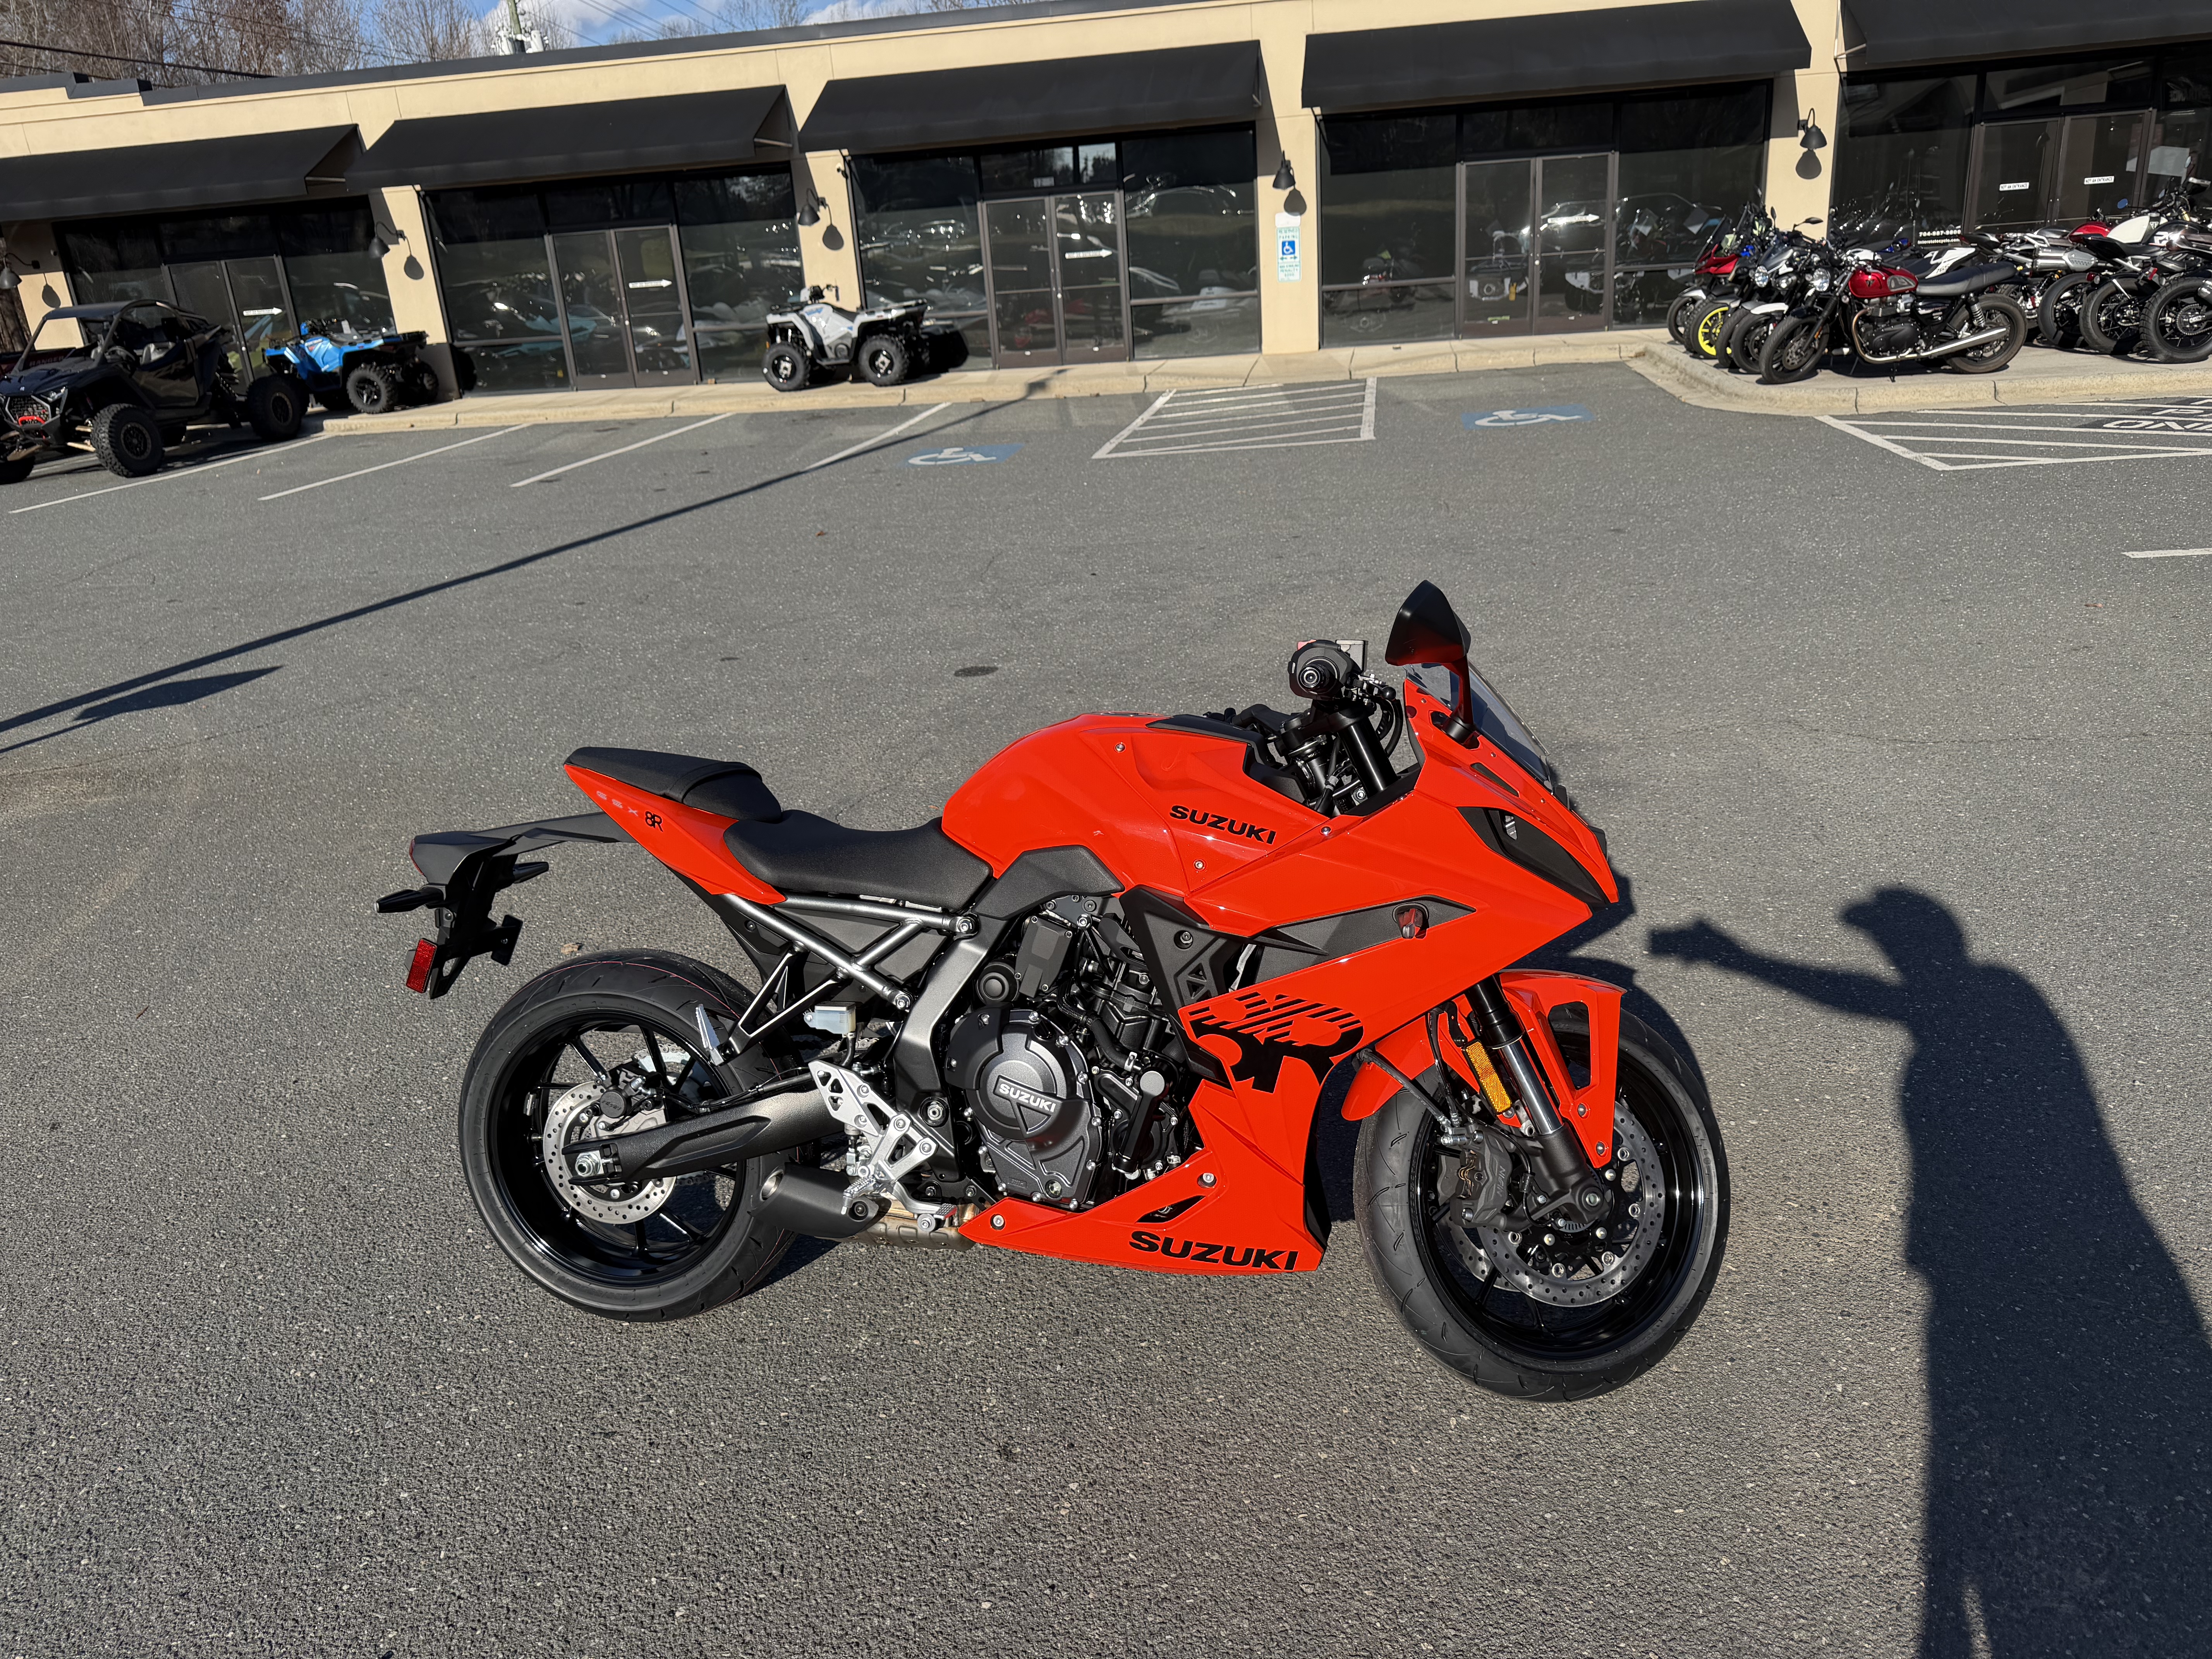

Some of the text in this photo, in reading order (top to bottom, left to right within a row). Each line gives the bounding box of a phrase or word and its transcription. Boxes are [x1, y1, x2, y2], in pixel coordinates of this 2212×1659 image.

[1169, 805, 1276, 845] SUZUKI
[999, 1083, 1056, 1113] SUZUKI
[1128, 1230, 1299, 1271] SUZUKI
